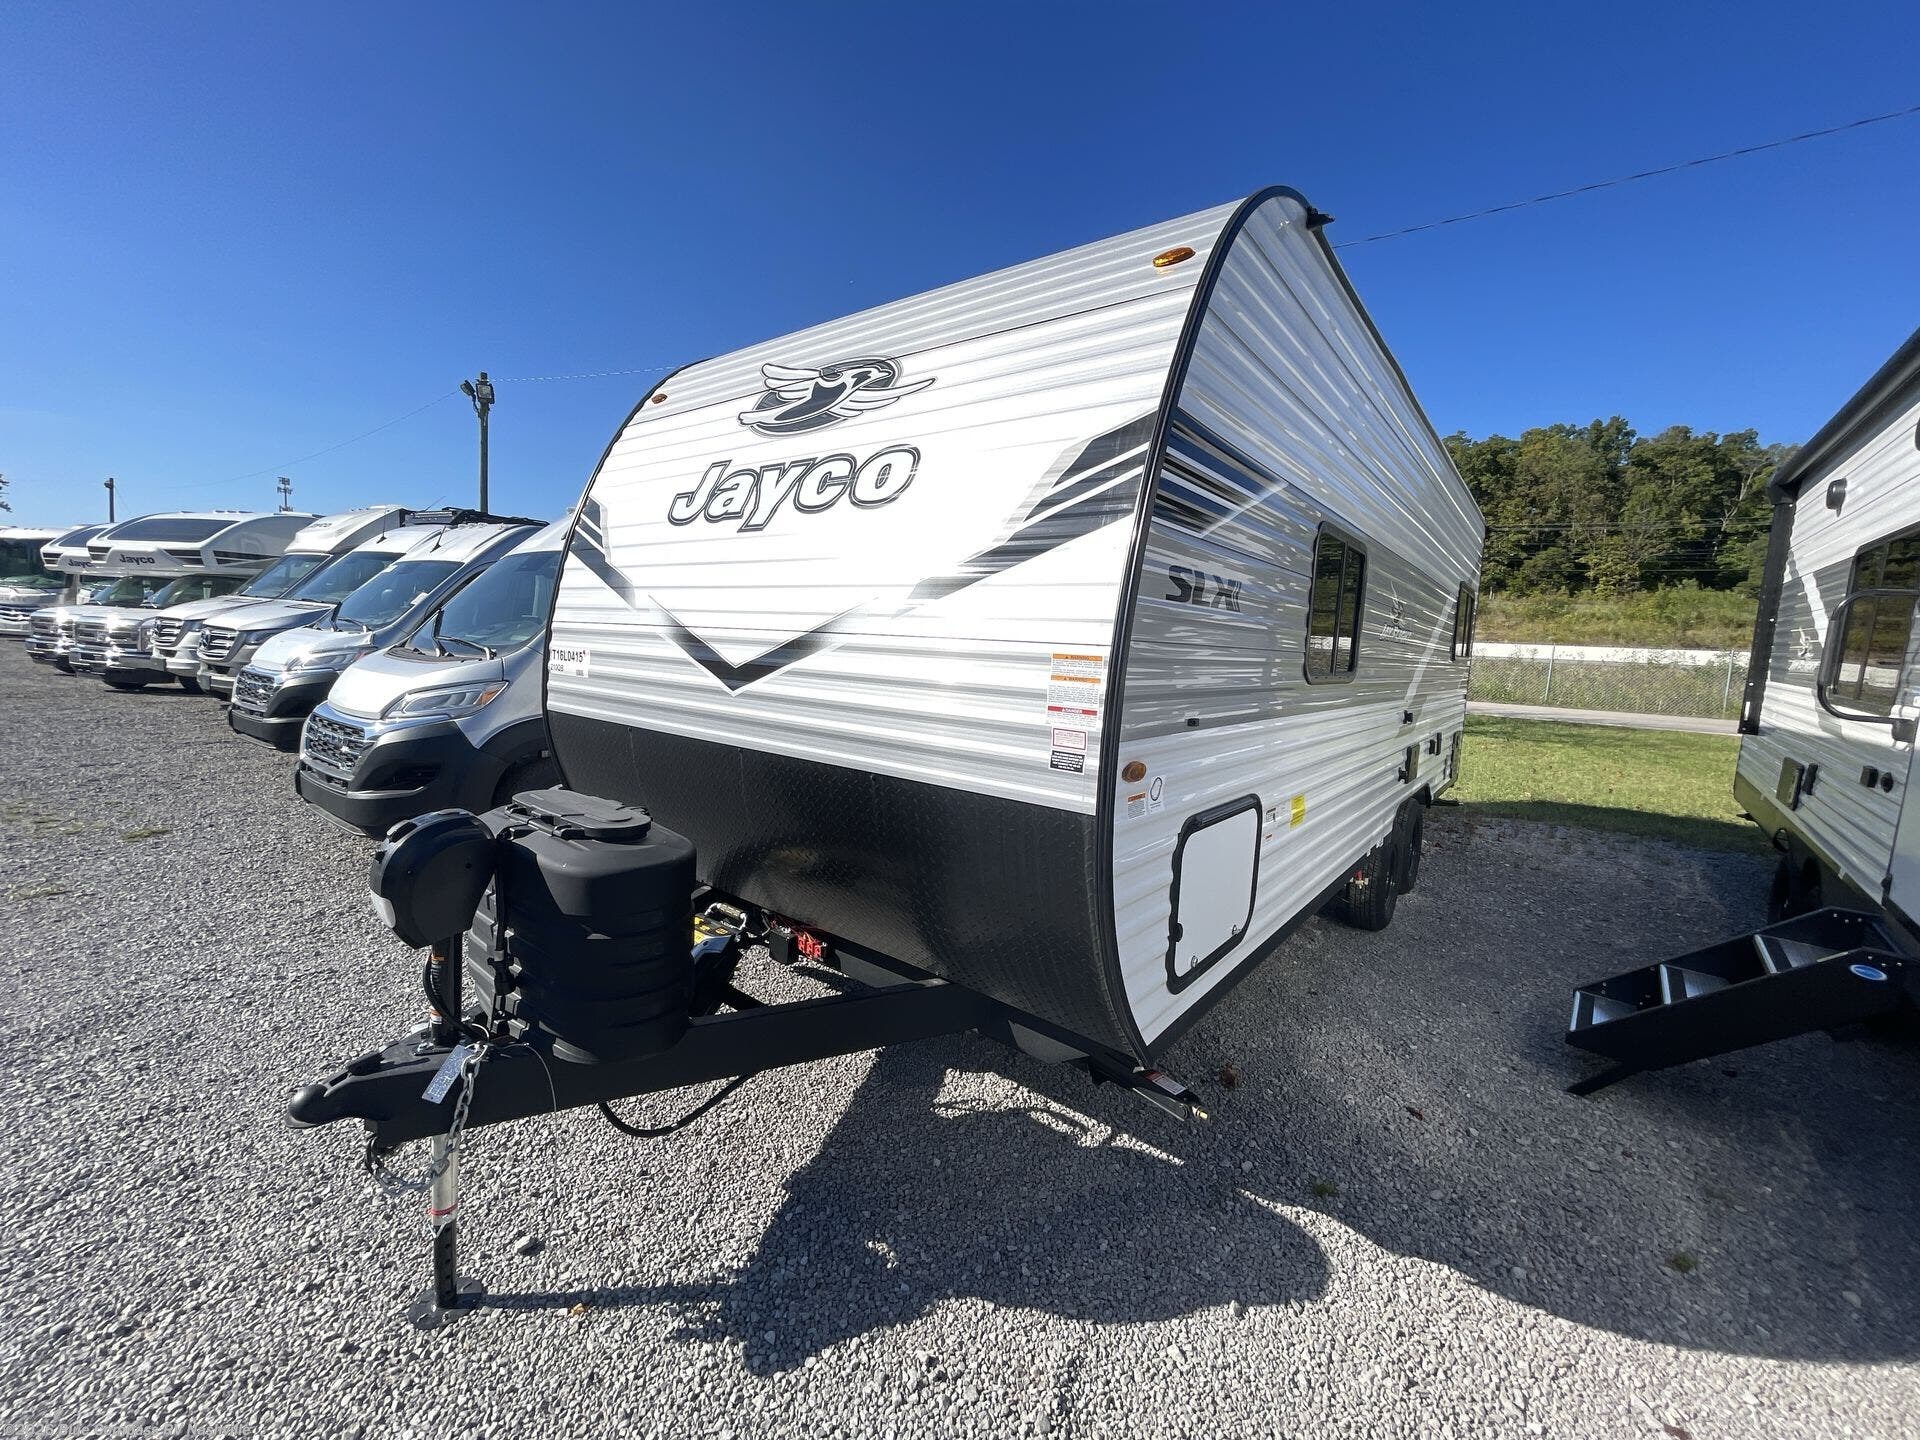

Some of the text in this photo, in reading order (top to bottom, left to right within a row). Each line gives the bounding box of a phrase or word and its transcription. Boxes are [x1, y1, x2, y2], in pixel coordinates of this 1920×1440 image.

[668, 444, 921, 533] Jayco
[119, 554, 156, 566] Jayco
[1166, 565, 1242, 612] SLX
